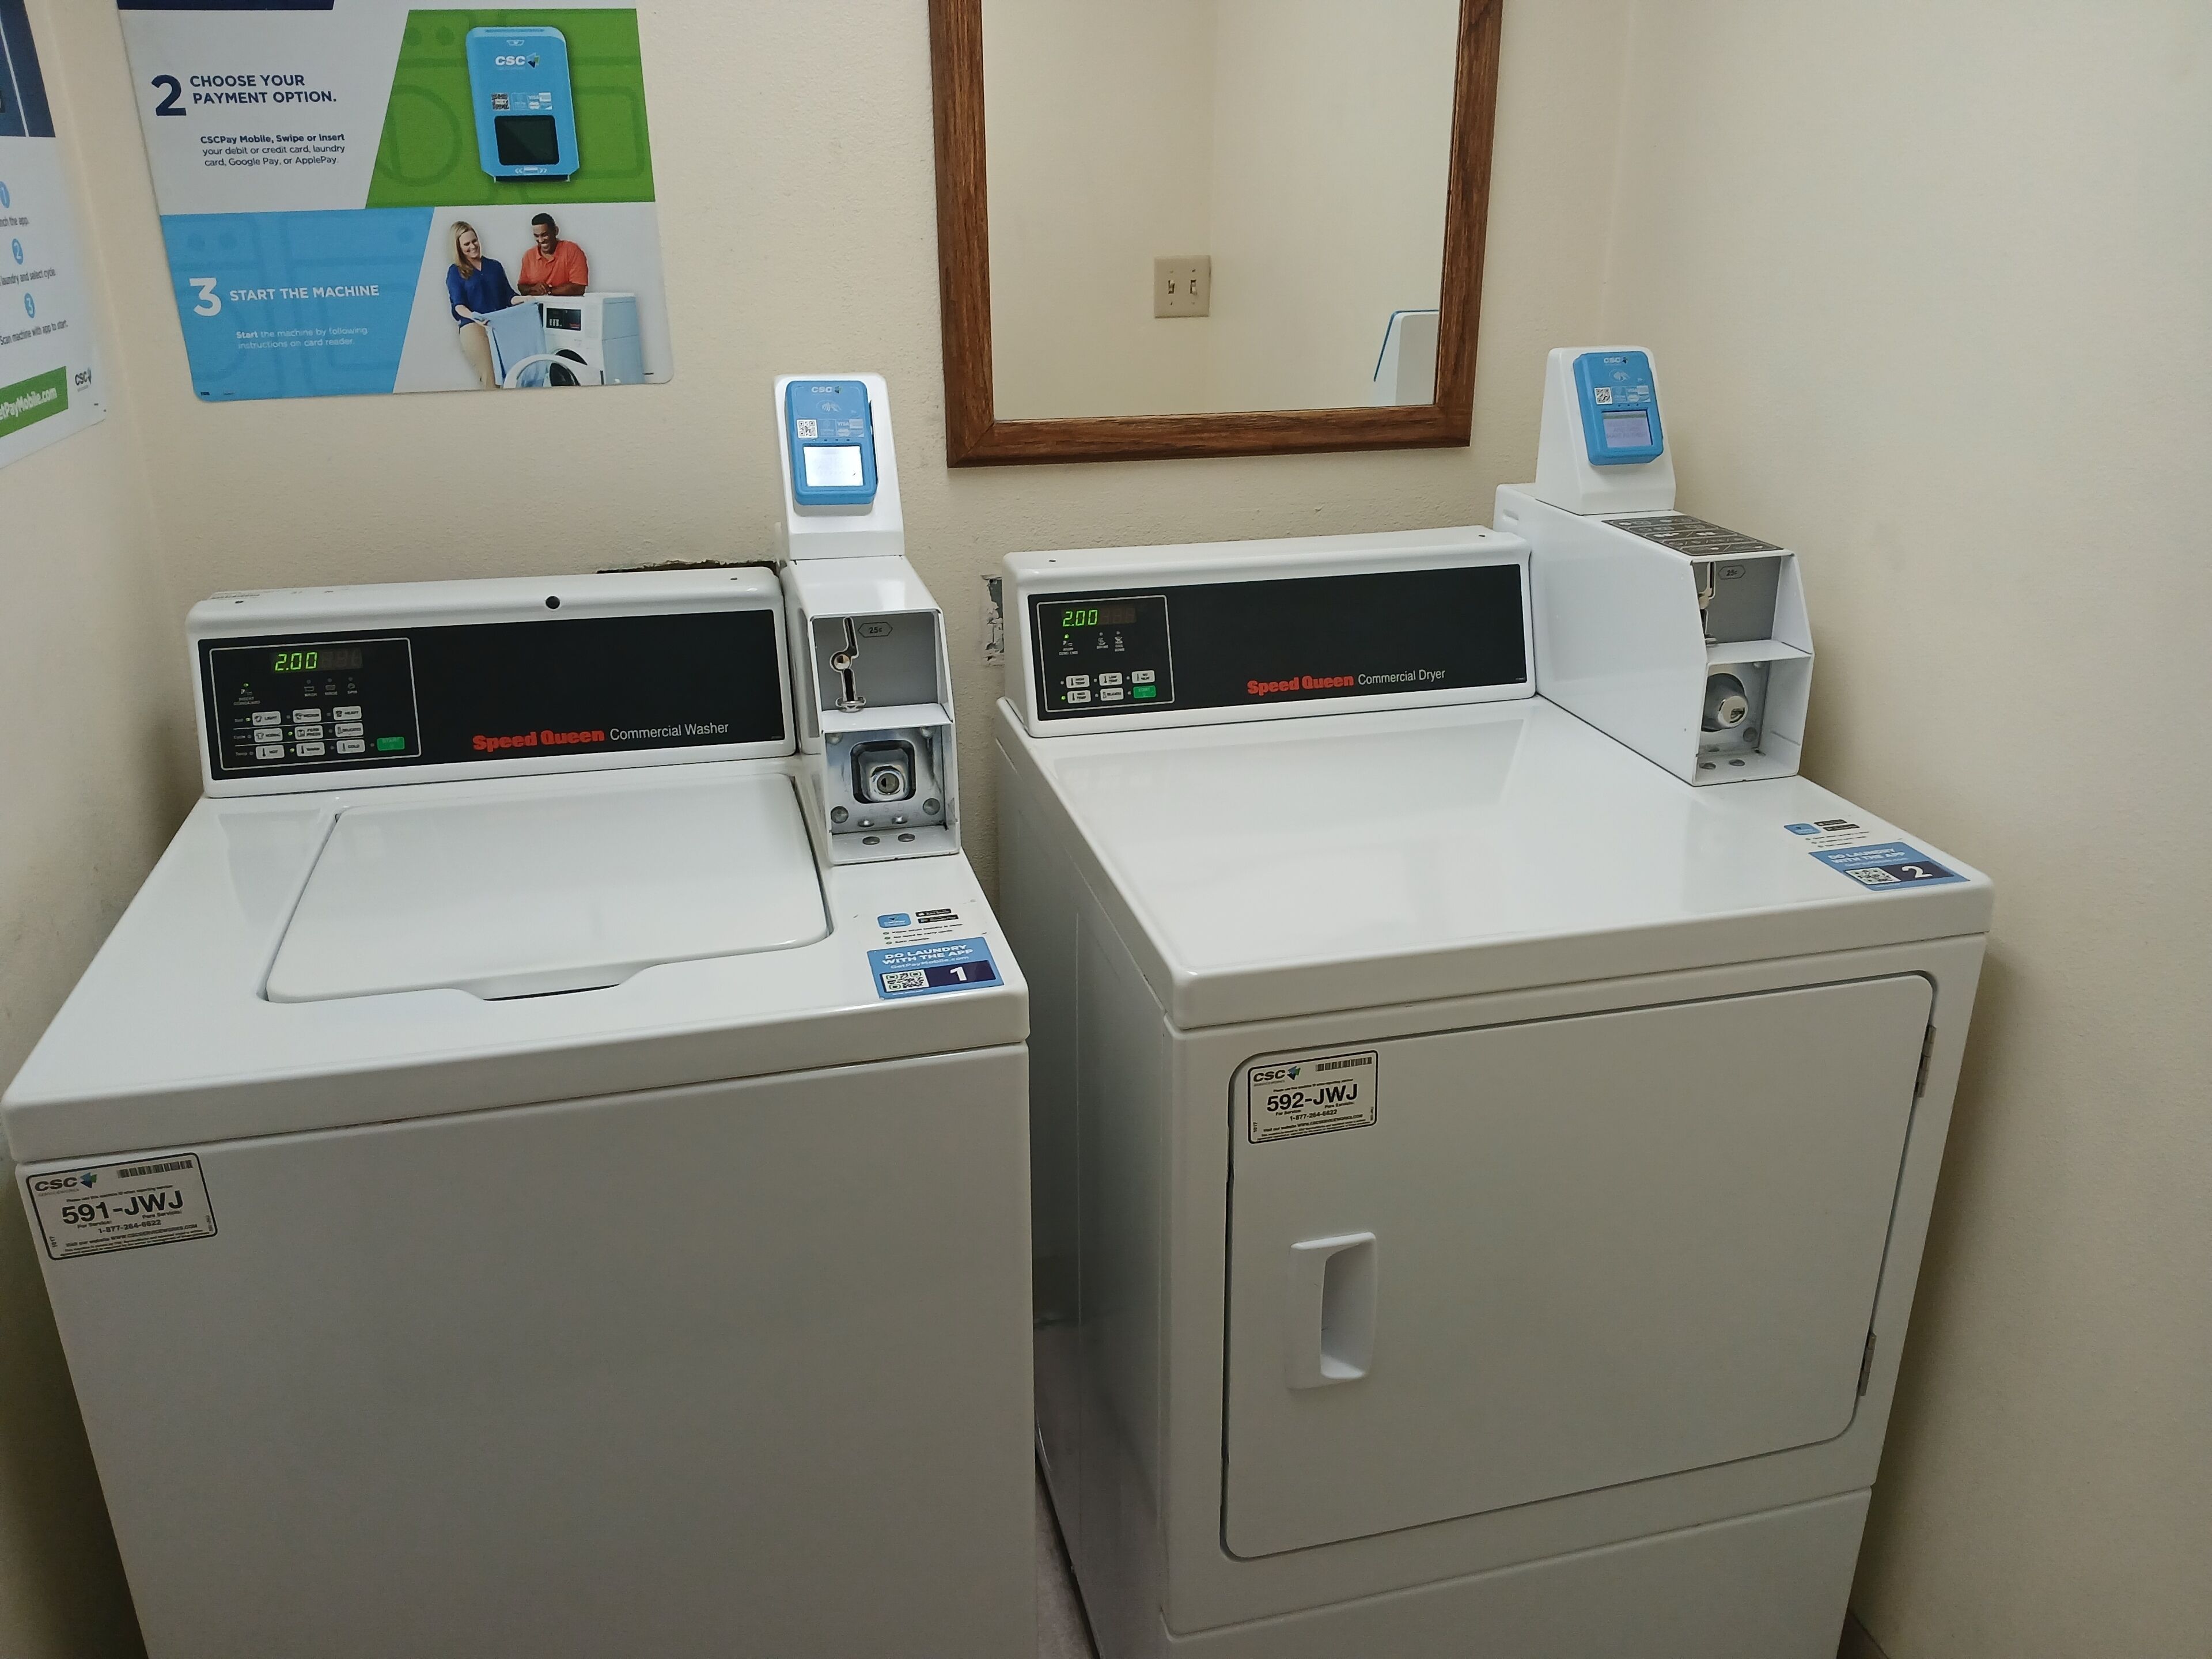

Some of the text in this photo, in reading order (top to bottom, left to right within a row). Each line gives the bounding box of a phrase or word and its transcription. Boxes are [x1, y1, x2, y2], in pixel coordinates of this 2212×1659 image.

[495, 55, 526, 66] CSC
[190, 74, 305, 87] CHOOSE YOUR
[151, 74, 187, 116] 2
[193, 91, 336, 104] PAYMENT OPTION.
[200, 136, 237, 144] CSCPay
[240, 135, 274, 143] Mobile,
[276, 135, 304, 143] Swipe
[319, 134, 344, 142] Insert
[225, 146, 248, 154] debit
[289, 146, 311, 154] card,
[313, 145, 345, 153] laundry
[229, 158, 260, 167] Google
[263, 157, 282, 166] Pay,
[13, 242, 21, 259] 2
[20, 270, 29, 282] and
[30, 270, 44, 280] select
[189, 277, 221, 316] 3
[229, 285, 379, 301] START THE MACHINE
[26, 297, 33, 315] 3
[0, 335, 12, 345] Scan
[43, 324, 51, 335] app
[51, 323, 56, 331] to
[236, 331, 259, 339] Start
[316, 328, 326, 336] by
[329, 327, 368, 336] following
[238, 341, 288, 349] instructions
[304, 339, 323, 347] card
[75, 371, 88, 385] CSC
[1062, 609, 1098, 627] 2.00
[275, 652, 318, 672] 2.00
[1247, 669, 1446, 696] Speed Queen Commercial Dryer
[472, 722, 729, 752] Speed Queen Commercial Washer
[1902, 865, 1933, 878] 2
[907, 945, 967, 956] LAUNDRY
[948, 949, 973, 957] APP
[950, 966, 967, 981] 1
[1253, 1070, 1286, 1082] CSC
[1267, 1084, 1358, 1112] 592-JWJ
[35, 1177, 78, 1191] CSC
[62, 1190, 184, 1225] 591-JWJ
[98, 1219, 161, 1234] 1-877-264-6622
